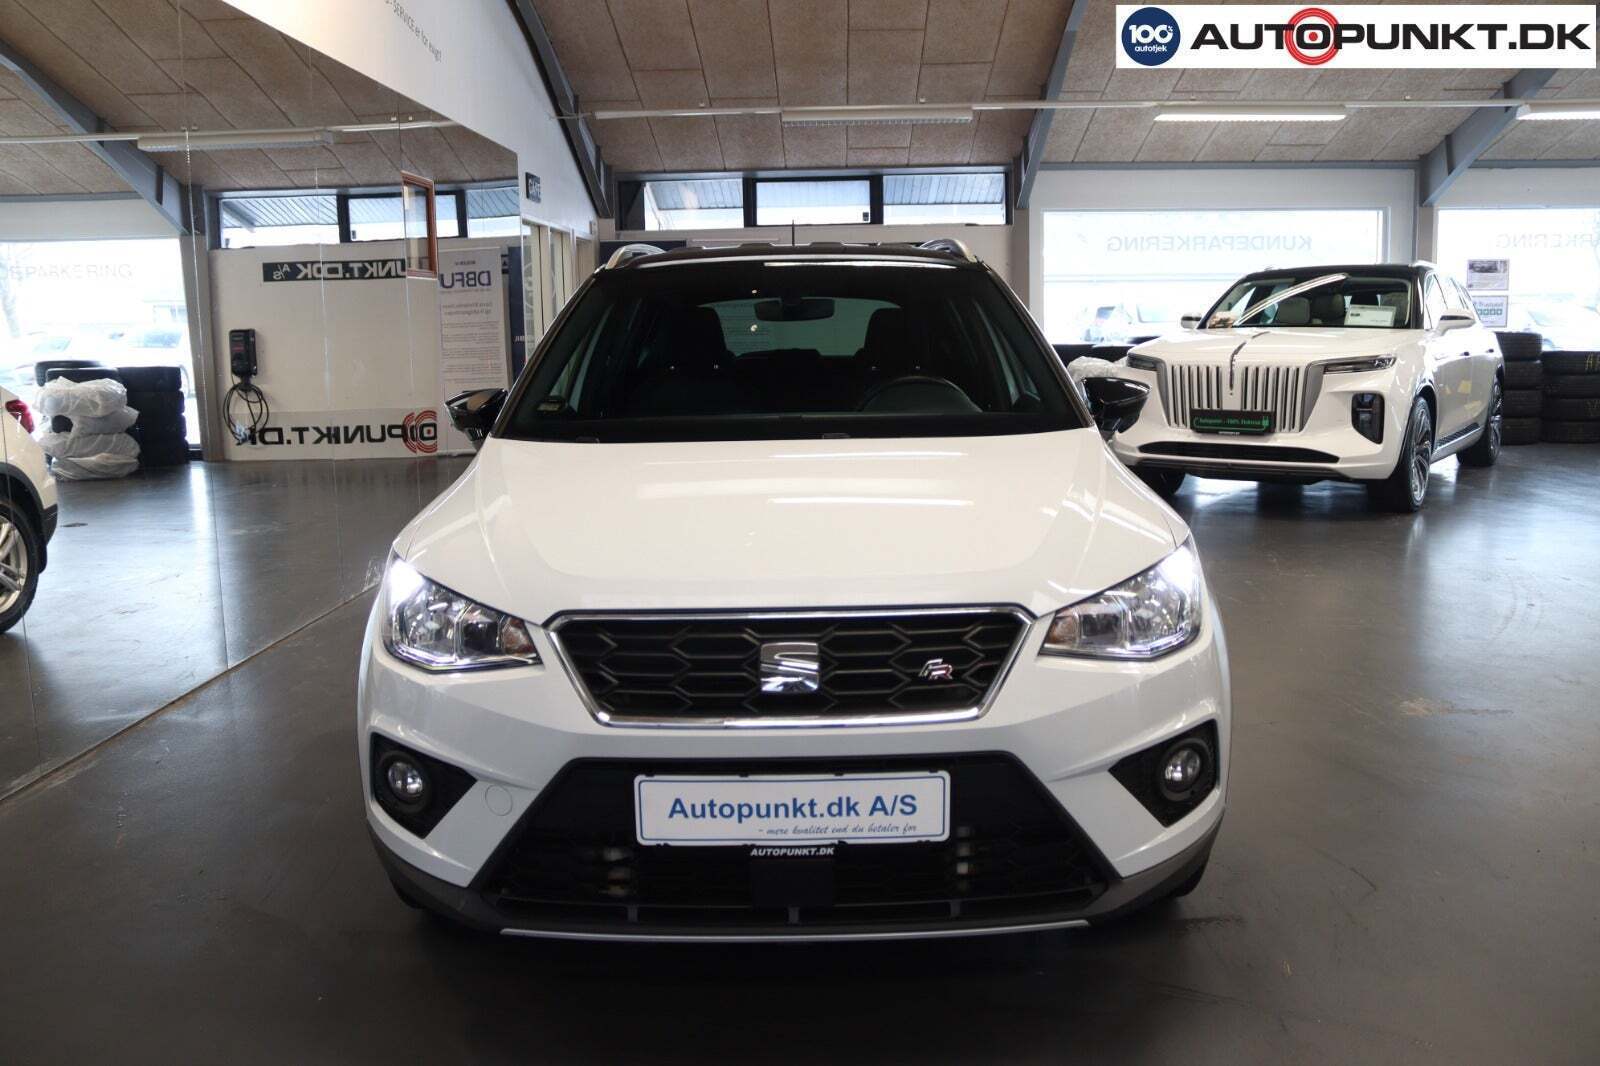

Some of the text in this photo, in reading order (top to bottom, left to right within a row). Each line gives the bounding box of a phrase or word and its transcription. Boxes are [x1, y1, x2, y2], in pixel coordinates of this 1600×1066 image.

[668, 794, 918, 824] Autopunkt.dk A/S
[766, 827, 789, 835] mere
[851, 824, 865, 833] du
[867, 822, 900, 834] betaler
[902, 823, 918, 835] for
[750, 847, 835, 857] AUTOPUNKT.DK
